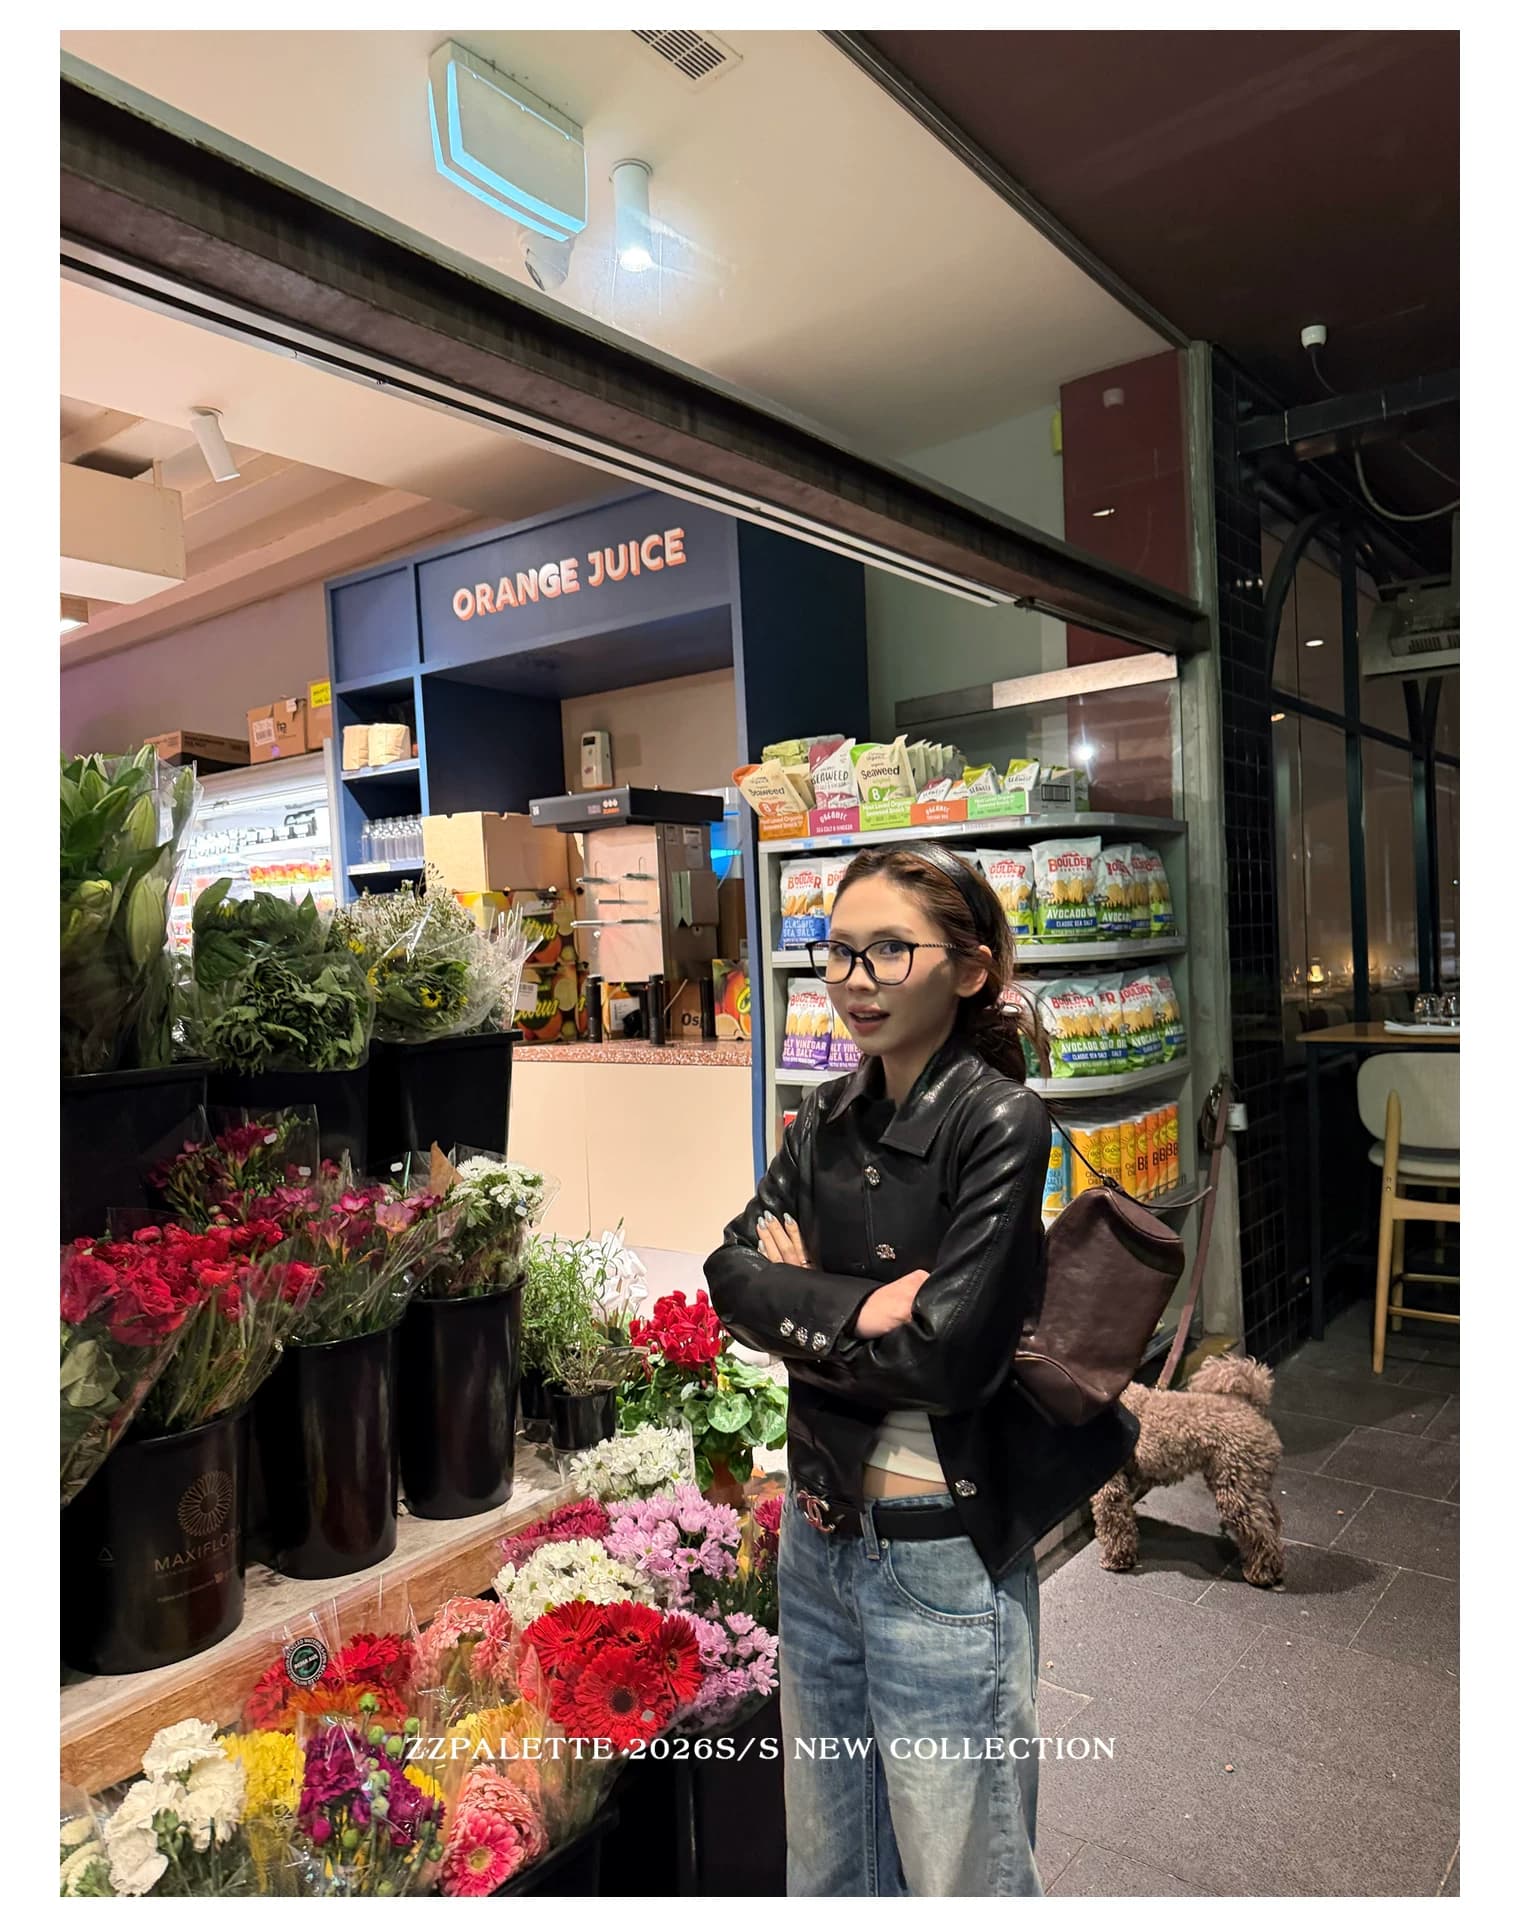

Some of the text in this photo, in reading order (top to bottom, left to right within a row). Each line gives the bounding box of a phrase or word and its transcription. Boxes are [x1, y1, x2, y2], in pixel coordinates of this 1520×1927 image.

[453, 527, 686, 621] ORANGE JUICE
[811, 770, 849, 785] SEAWEED
[861, 765, 900, 780] Seaweed
[872, 789, 880, 801] 8
[1047, 856, 1093, 873] BOULDER
[787, 873, 822, 889] BOULDER
[1047, 909, 1086, 919] AVOCADO
[784, 920, 814, 929] CLASSIC
[784, 928, 816, 938] SEA SALT
[790, 993, 827, 1008] BOULDER
[1051, 995, 1095, 1009] BOULDER
[795, 1039, 827, 1051] VINEGAR
[1061, 1041, 1098, 1053] AVOCADO
[795, 1048, 812, 1058] SALT
